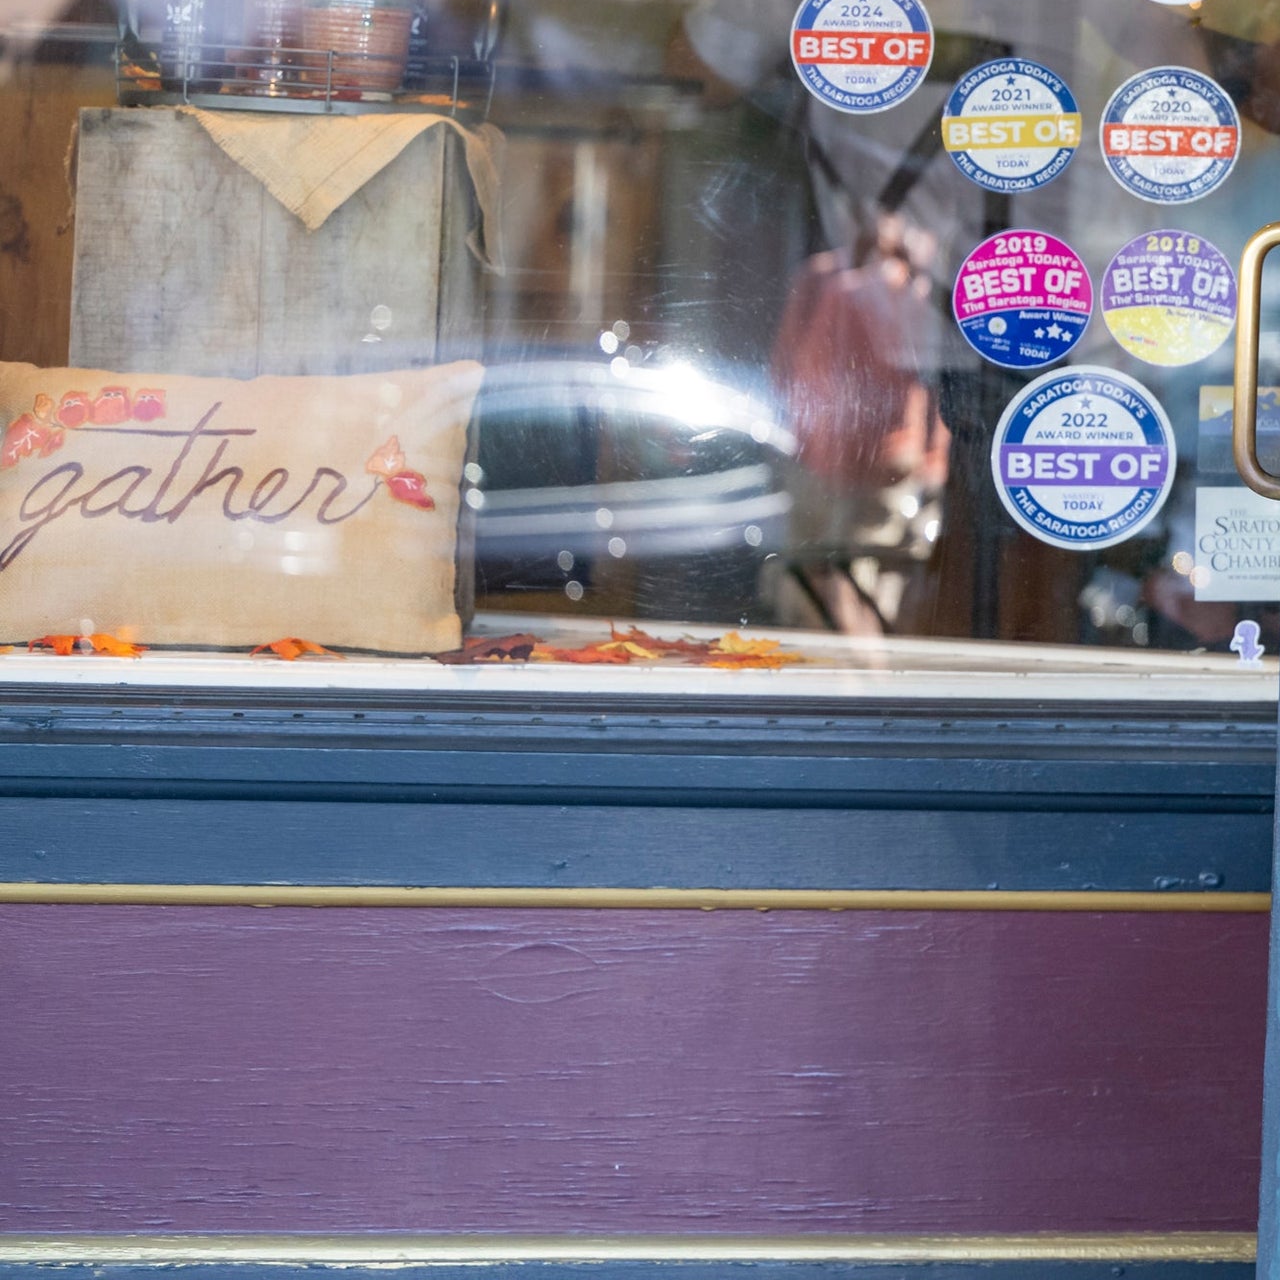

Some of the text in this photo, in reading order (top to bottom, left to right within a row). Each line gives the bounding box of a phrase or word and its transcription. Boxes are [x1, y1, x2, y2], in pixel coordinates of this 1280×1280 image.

[841, 5, 883, 18] 2024
[863, 20, 902, 28] WINNER
[800, 37, 925, 61] BEST OF
[807, 66, 918, 106] THE SARATOGA REGION
[845, 76, 877, 84] TODAY
[960, 62, 1062, 96] SARATOGA TODAY'S
[992, 88, 1031, 101] 2021
[1122, 75, 1220, 106] SARATOGA TODAY'S
[971, 103, 1052, 112] AWARD WINNER
[1151, 100, 1192, 113] 2020
[948, 119, 1076, 145] BEST OF
[1110, 129, 1232, 154] BEST OF
[957, 150, 1070, 190] THE SARATOGA REGION
[996, 160, 1030, 168] TODAY
[1132, 175, 1188, 195] SARATOGA
[1188, 159, 1224, 192] REGION
[994, 236, 1047, 255] 2019
[1146, 236, 1200, 254] 2018
[967, 253, 1078, 272] Saratoga TODAY's
[962, 267, 1082, 300] BEST OF
[1112, 267, 1230, 299] BEST OF
[962, 294, 1086, 314] The Saratoga Region
[1019, 310, 1086, 324] Award Winner
[1019, 347, 1050, 359] TODAY
[1023, 380, 1147, 419] SARATOGA TODAY'S
[1061, 413, 1108, 428] 2022
[1036, 430, 1133, 441] AWARD WINNER
[1007, 452, 1162, 480] BEST OF
[0, 402, 384, 571] gather
[1015, 490, 1153, 537] THE SARATOGA REGION
[1063, 500, 1103, 510] TODAY
[1199, 534, 1276, 554] COUNTY
